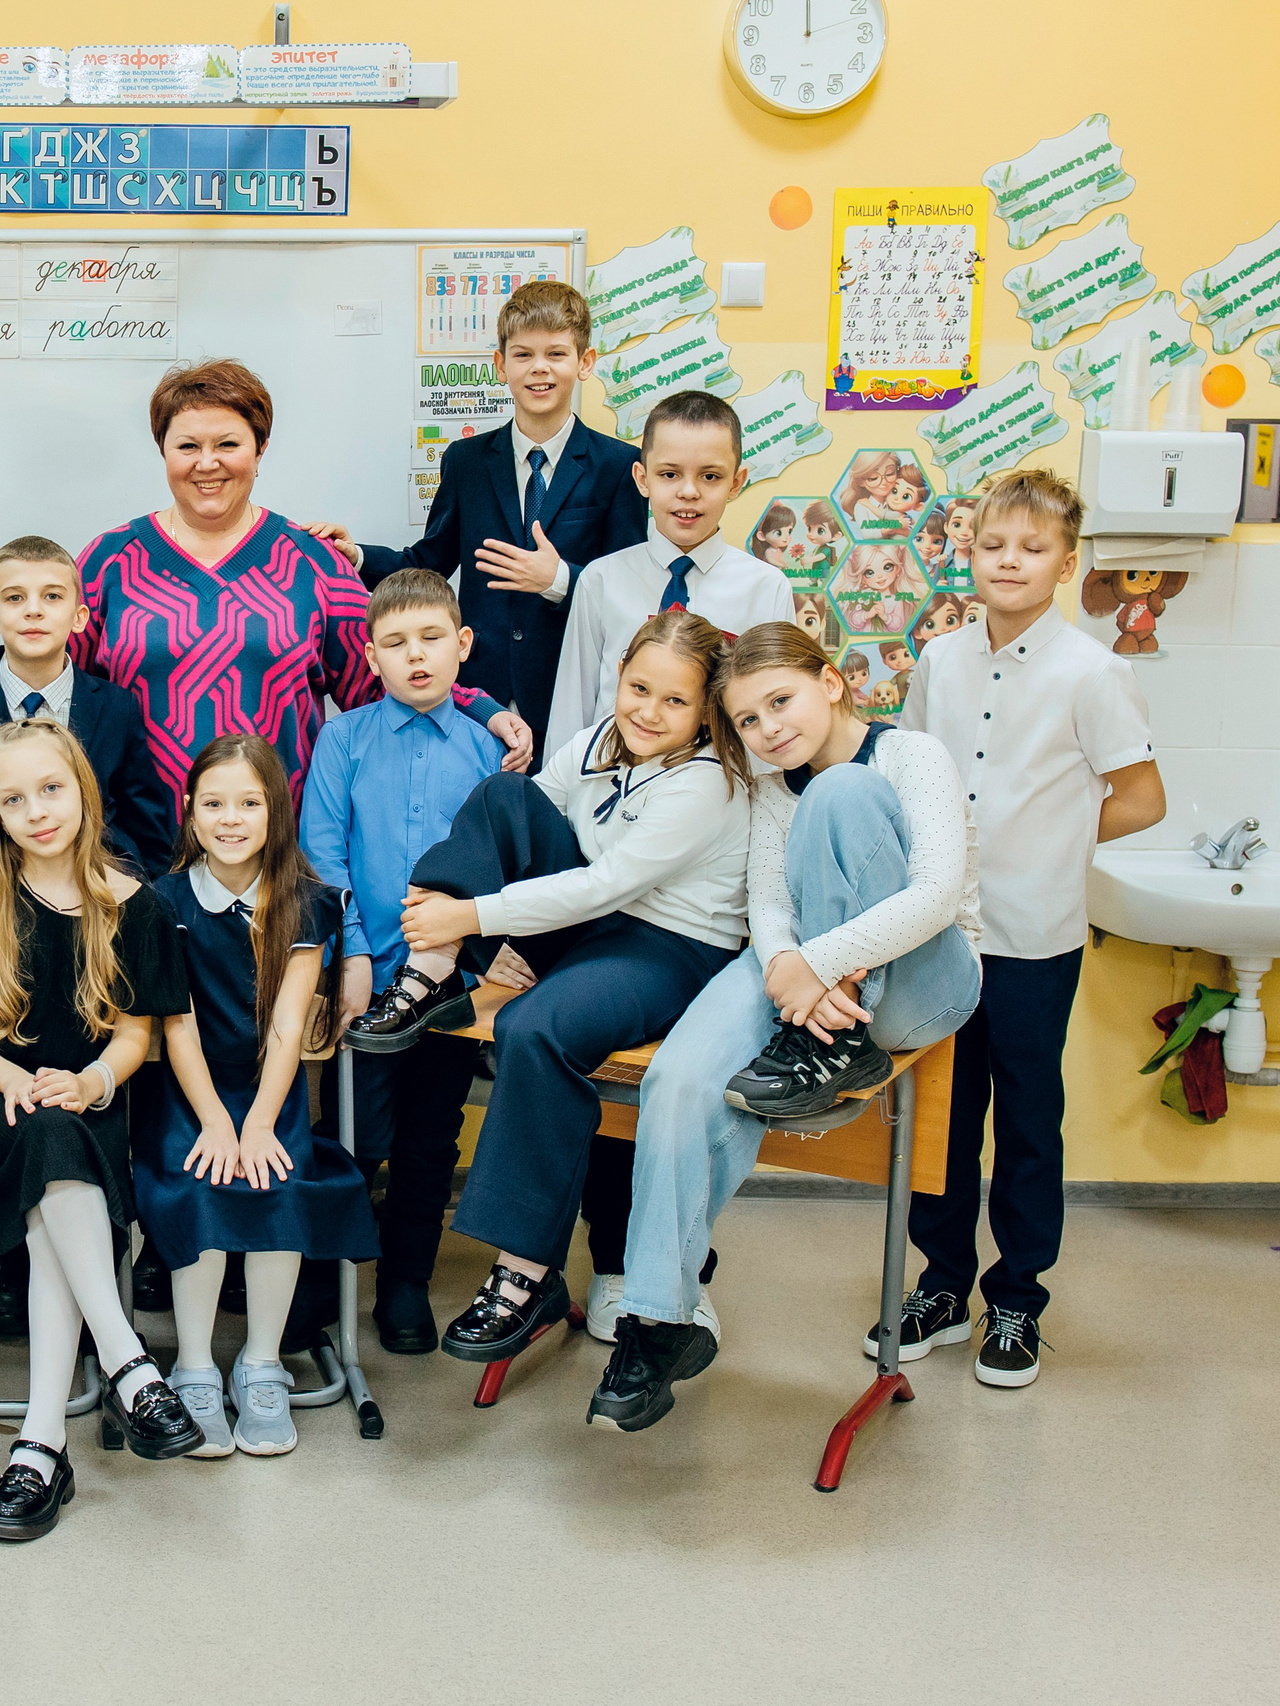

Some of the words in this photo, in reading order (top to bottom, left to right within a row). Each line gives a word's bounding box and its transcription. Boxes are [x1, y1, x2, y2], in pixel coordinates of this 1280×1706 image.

[748, 0, 773, 16] 10
[850, 0, 867, 14] 2
[743, 25, 759, 46] 9
[857, 23, 873, 43] 3
[271, 51, 338, 63] эпитет
[750, 54, 766, 75] 8
[848, 52, 865, 73] 4
[287, 73, 337, 81] определение
[771, 76, 786, 96] 7
[827, 74, 843, 94] 5
[798, 83, 815, 103] 6
[2, 131, 23, 162] Г
[35, 132, 65, 167] Д
[71, 132, 108, 164] Ж
[117, 132, 140, 164] З
[318, 134, 339, 166] Ь
[998, 173, 1050, 205] Хорошая
[1050, 157, 1084, 179] книга
[1085, 142, 1112, 162] ярче
[1074, 163, 1117, 190] светит
[0, 173, 25, 205] К
[39, 173, 64, 204] Т
[72, 173, 106, 205] Ш
[116, 174, 140, 205] С
[153, 174, 182, 205] Х
[194, 174, 222, 209] Ц
[234, 175, 256, 206] Ч
[267, 174, 303, 210] Щ
[311, 175, 337, 207] Ъ
[848, 205, 882, 217] ПИШИ
[902, 204, 974, 216] ПРАВИЛЬНО
[453, 251, 478, 259] КЛАССЫ
[486, 251, 515, 259] РАЗРЯДЫ
[517, 250, 535, 258] ЧИСЕЛ
[35, 246, 161, 293] декабря
[1202, 276, 1239, 300] Книга
[1238, 247, 1280, 279] поможе
[426, 276, 455, 295] 835
[460, 276, 488, 295] 772
[605, 278, 645, 303] умного
[646, 259, 688, 283] соседа
[1027, 278, 1065, 302] Книга
[1064, 261, 1094, 283] твой
[1032, 307, 1054, 324] без
[1076, 284, 1098, 301] как
[1098, 273, 1119, 289] без
[599, 301, 640, 325] книгой
[43, 305, 171, 352] работа
[661, 336, 707, 361] книжки
[657, 361, 701, 386] будешь
[445, 391, 484, 399] ВНУТРЕННЯЯ
[433, 407, 472, 415] ОБОЗНАЧАТЬ
[474, 405, 498, 413] БУКВОЙ
[934, 417, 976, 444] Золото
[978, 383, 1035, 423] добывают
[998, 424, 1006, 433] а
[1006, 402, 1045, 429] знания
[744, 410, 785, 434] читать
[770, 423, 803, 445] знать
[836, 591, 882, 601] ДОБРОТА
